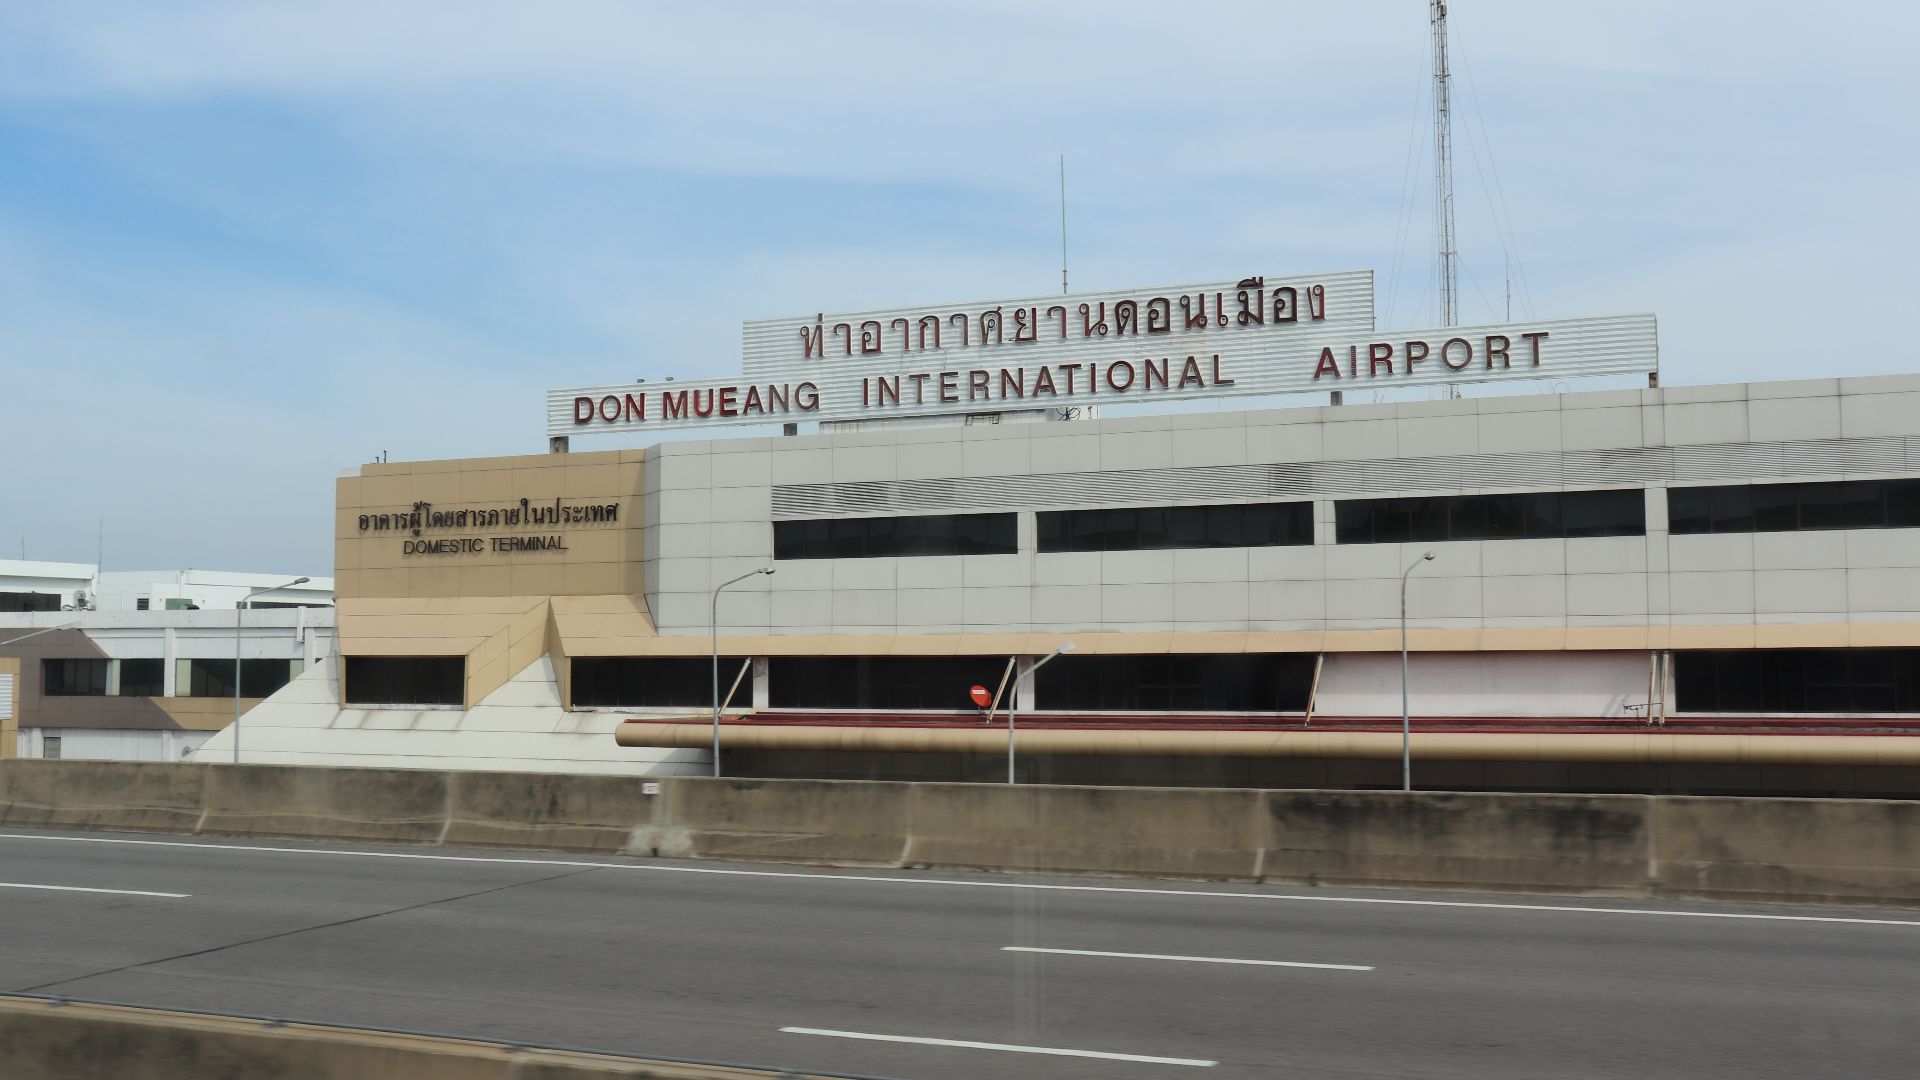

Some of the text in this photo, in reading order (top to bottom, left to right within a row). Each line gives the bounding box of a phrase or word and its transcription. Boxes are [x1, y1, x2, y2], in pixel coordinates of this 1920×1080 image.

[799, 276, 1326, 358] ท่าอากาศยานดอนเมือง
[573, 331, 1550, 425] DON MUEANG INTERNATIONAL AIRPORT
[358, 497, 619, 537] อาคารผู้โดยสารภายในประเทศ
[403, 536, 568, 555] DOMESTIC TERMINAL
